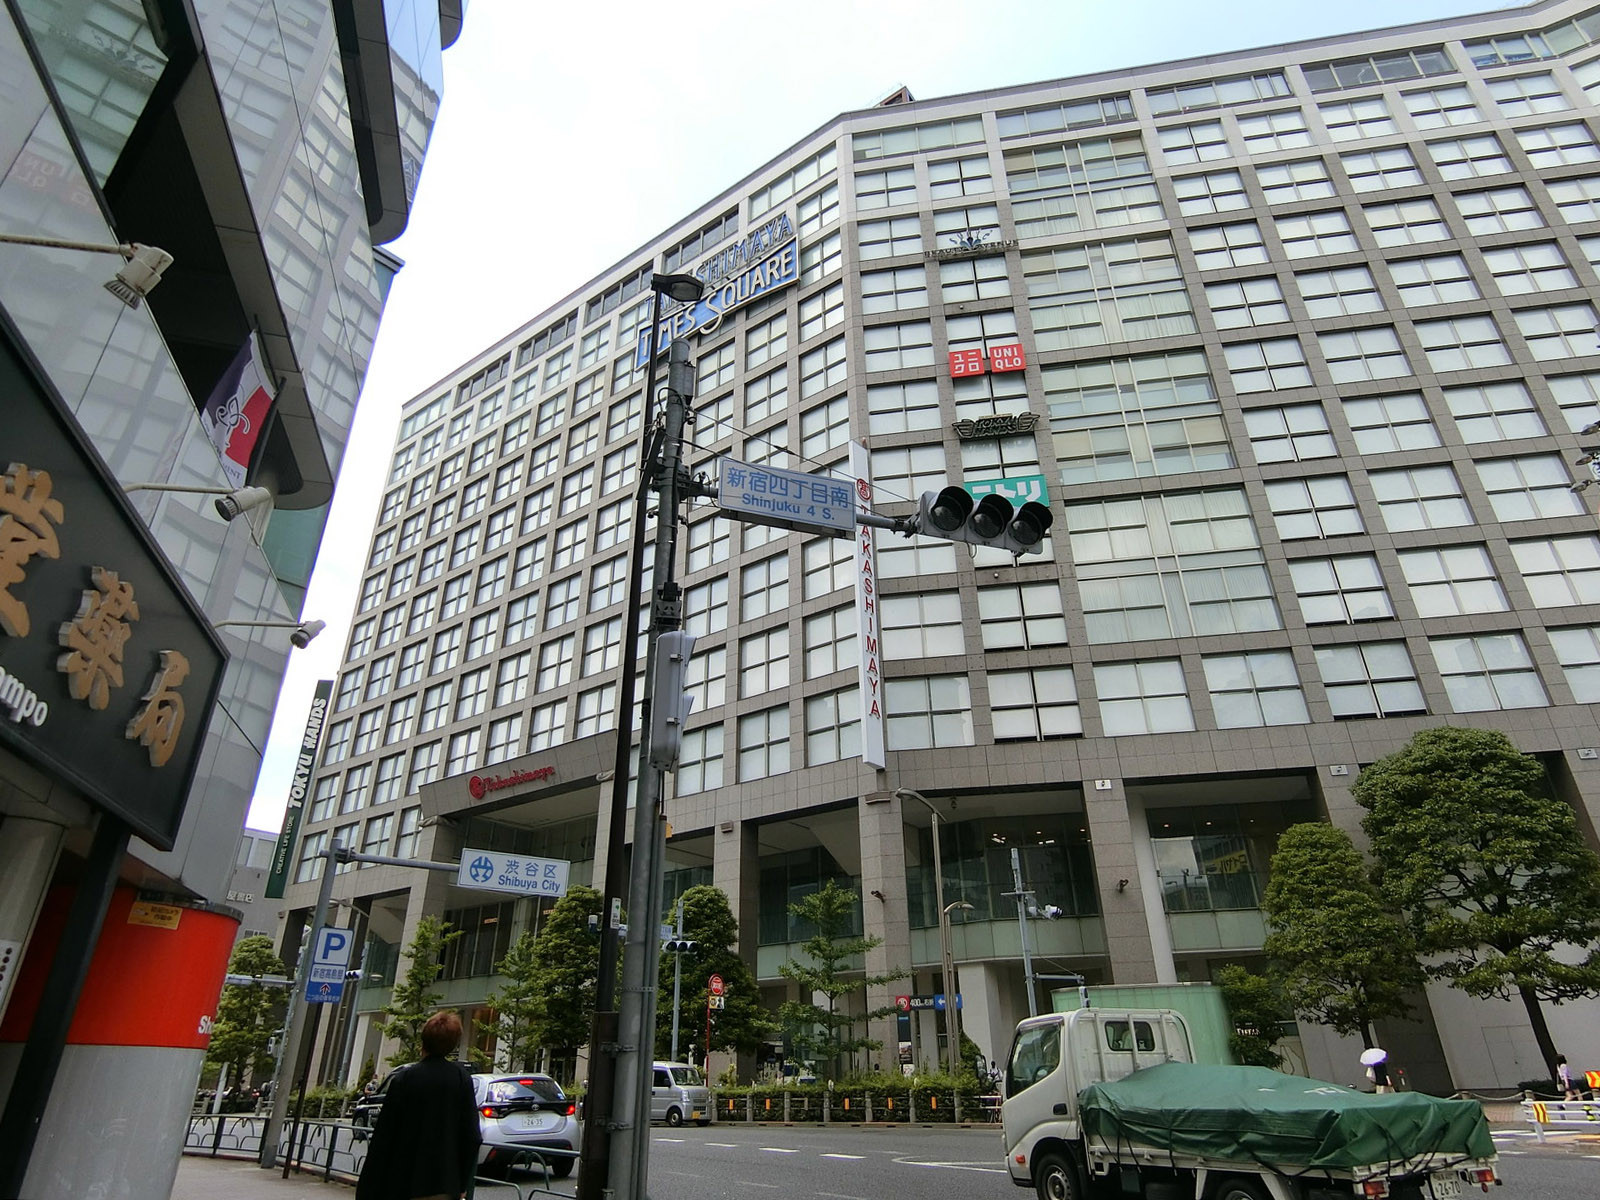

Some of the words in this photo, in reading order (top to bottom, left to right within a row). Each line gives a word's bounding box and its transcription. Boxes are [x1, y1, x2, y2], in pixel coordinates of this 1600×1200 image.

[646, 213, 793, 323] TASHIMAYA
[642, 304, 697, 357] TMES
[700, 248, 794, 335] SQUARE
[994, 347, 1019, 358] UNI
[995, 358, 1022, 369] QLO
[727, 466, 849, 509] 新宿四丁目南
[972, 480, 1042, 502] ニトリ
[742, 493, 800, 514] Shinjuku
[806, 505, 816, 517] 4
[822, 507, 835, 520] S.
[860, 504, 881, 720] TAKASHIMAYA
[288, 753, 314, 809] TOKYU
[304, 697, 328, 749] HANDS
[484, 766, 556, 793] Takashimaya
[286, 815, 295, 832] STORE
[283, 833, 291, 848] LIFE
[276, 847, 288, 875] CREATIVE
[505, 859, 558, 879] 渋谷区
[498, 874, 538, 890] Shibuya
[541, 880, 560, 893] City
[322, 932, 346, 960] P
